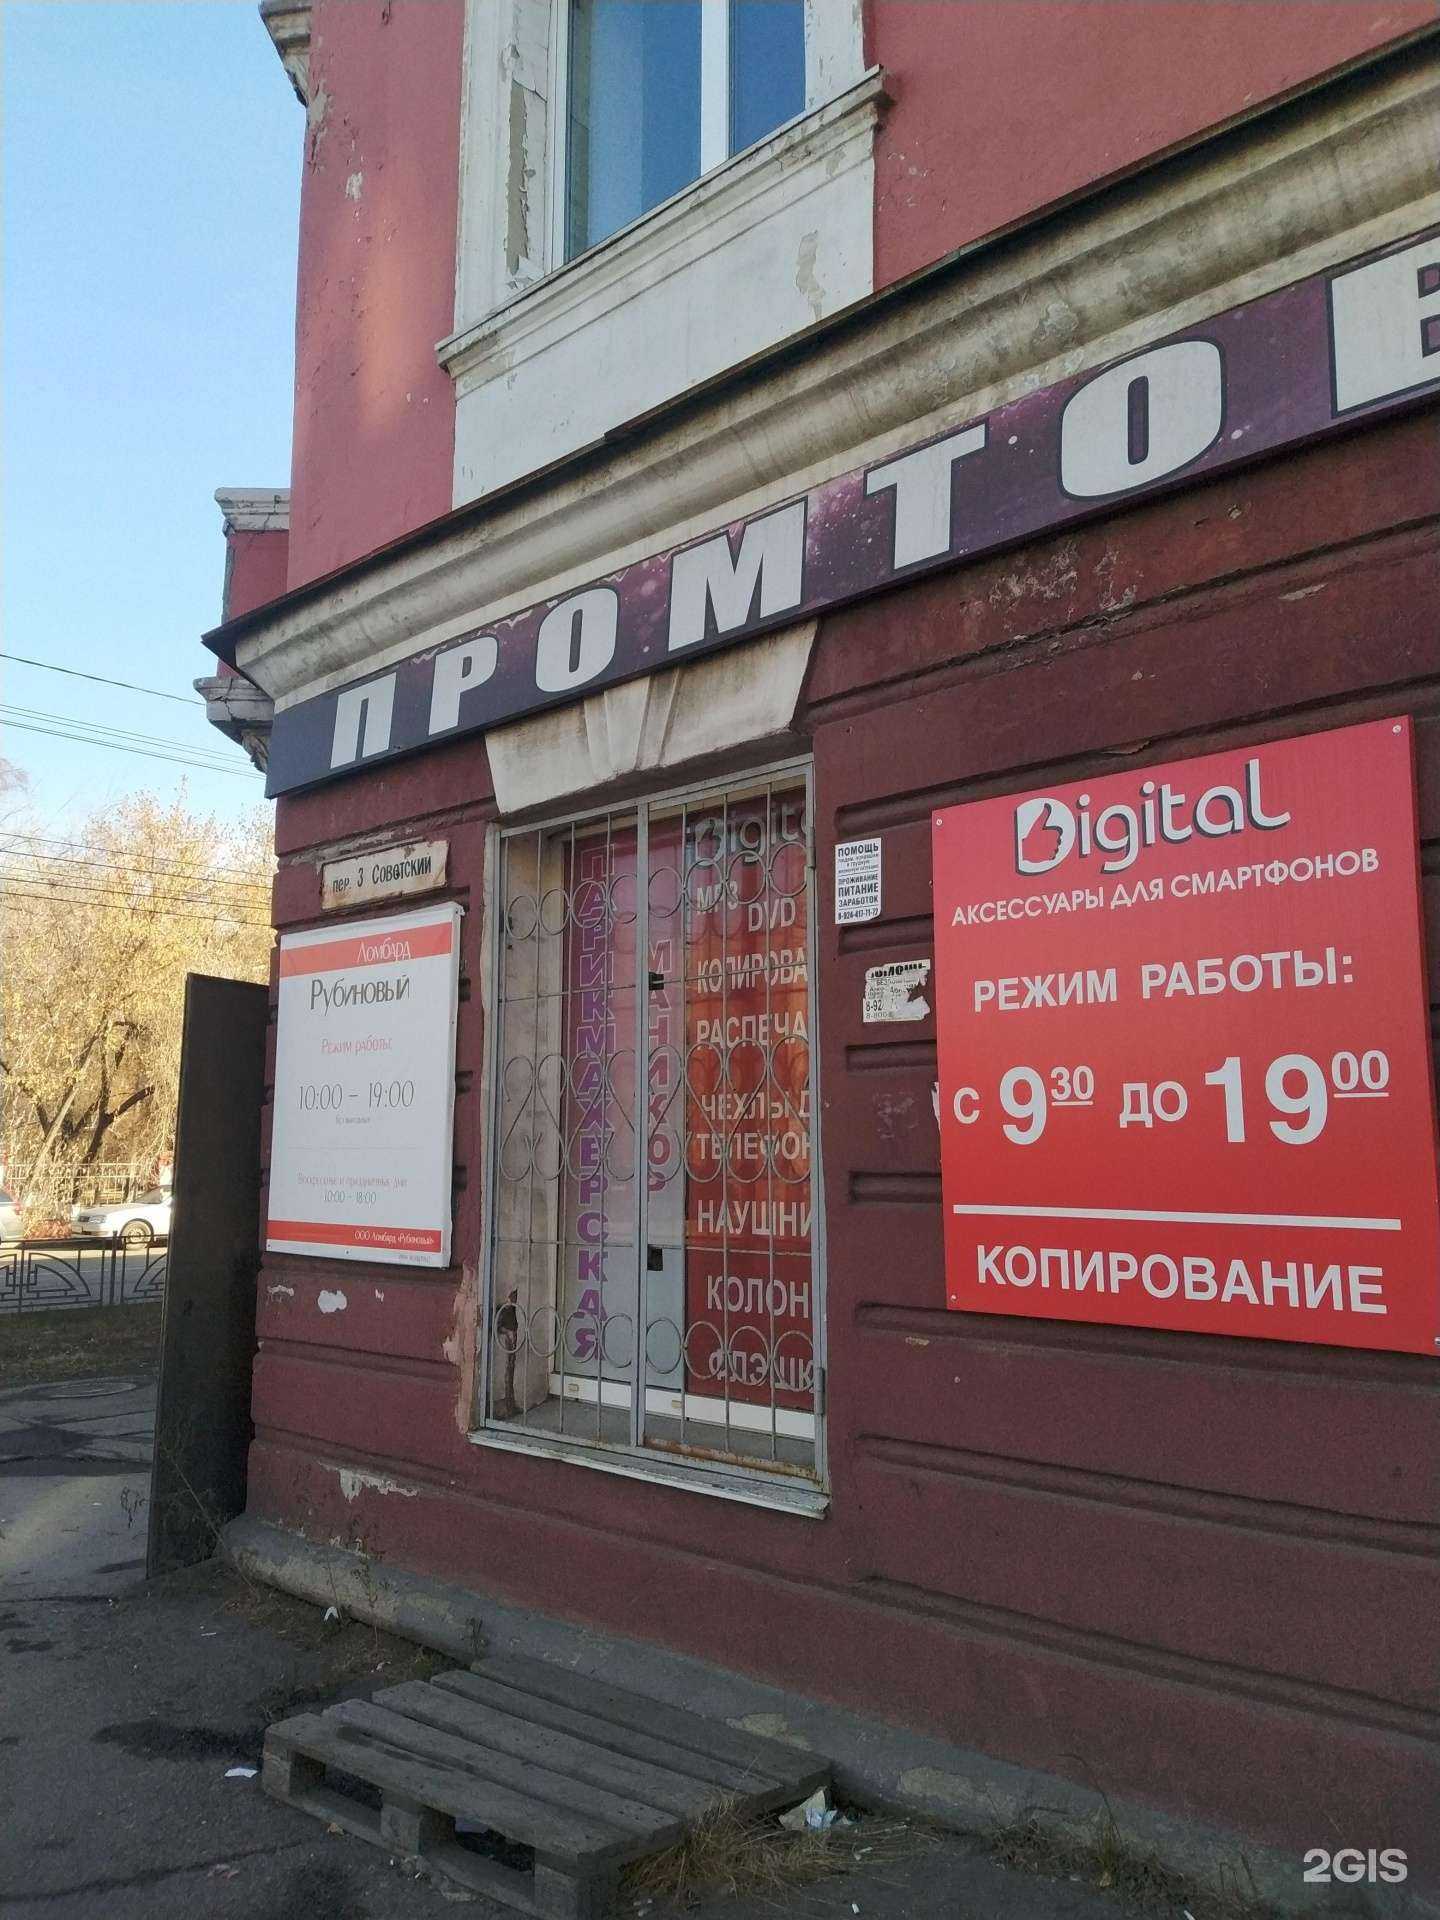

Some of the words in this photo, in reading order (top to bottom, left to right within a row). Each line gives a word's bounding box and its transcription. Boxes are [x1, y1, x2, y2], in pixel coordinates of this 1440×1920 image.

[838, 843, 879, 858] ПОМОЩЬ
[357, 867, 365, 888] 3
[838, 873, 878, 886] ПРОЖИВАНИЕ
[838, 882, 879, 898] ПИТАНИЕ
[950, 886, 1105, 927] АКСЕССУАРЫ
[1110, 878, 1165, 910] ДЛЯ
[1170, 848, 1380, 898] СМАРТФОНОВ
[748, 897, 797, 932] DVD
[838, 894, 879, 908] ЗАРАБОТОК
[357, 937, 412, 964] Ломбард
[974, 967, 1118, 1012] РЕЖИМ
[1141, 946, 1354, 1000] РАБОТЫ:
[310, 974, 410, 1016] Рубиновый
[299, 1083, 343, 1111] 10:00
[368, 1080, 414, 1108] 19:00
[1119, 1081, 1188, 1128] ДО
[354, 1231, 370, 1241] ООО
[976, 1243, 1387, 1315] КОПИРОВАНИЕ
[707, 1274, 809, 1319] КОЛОН
